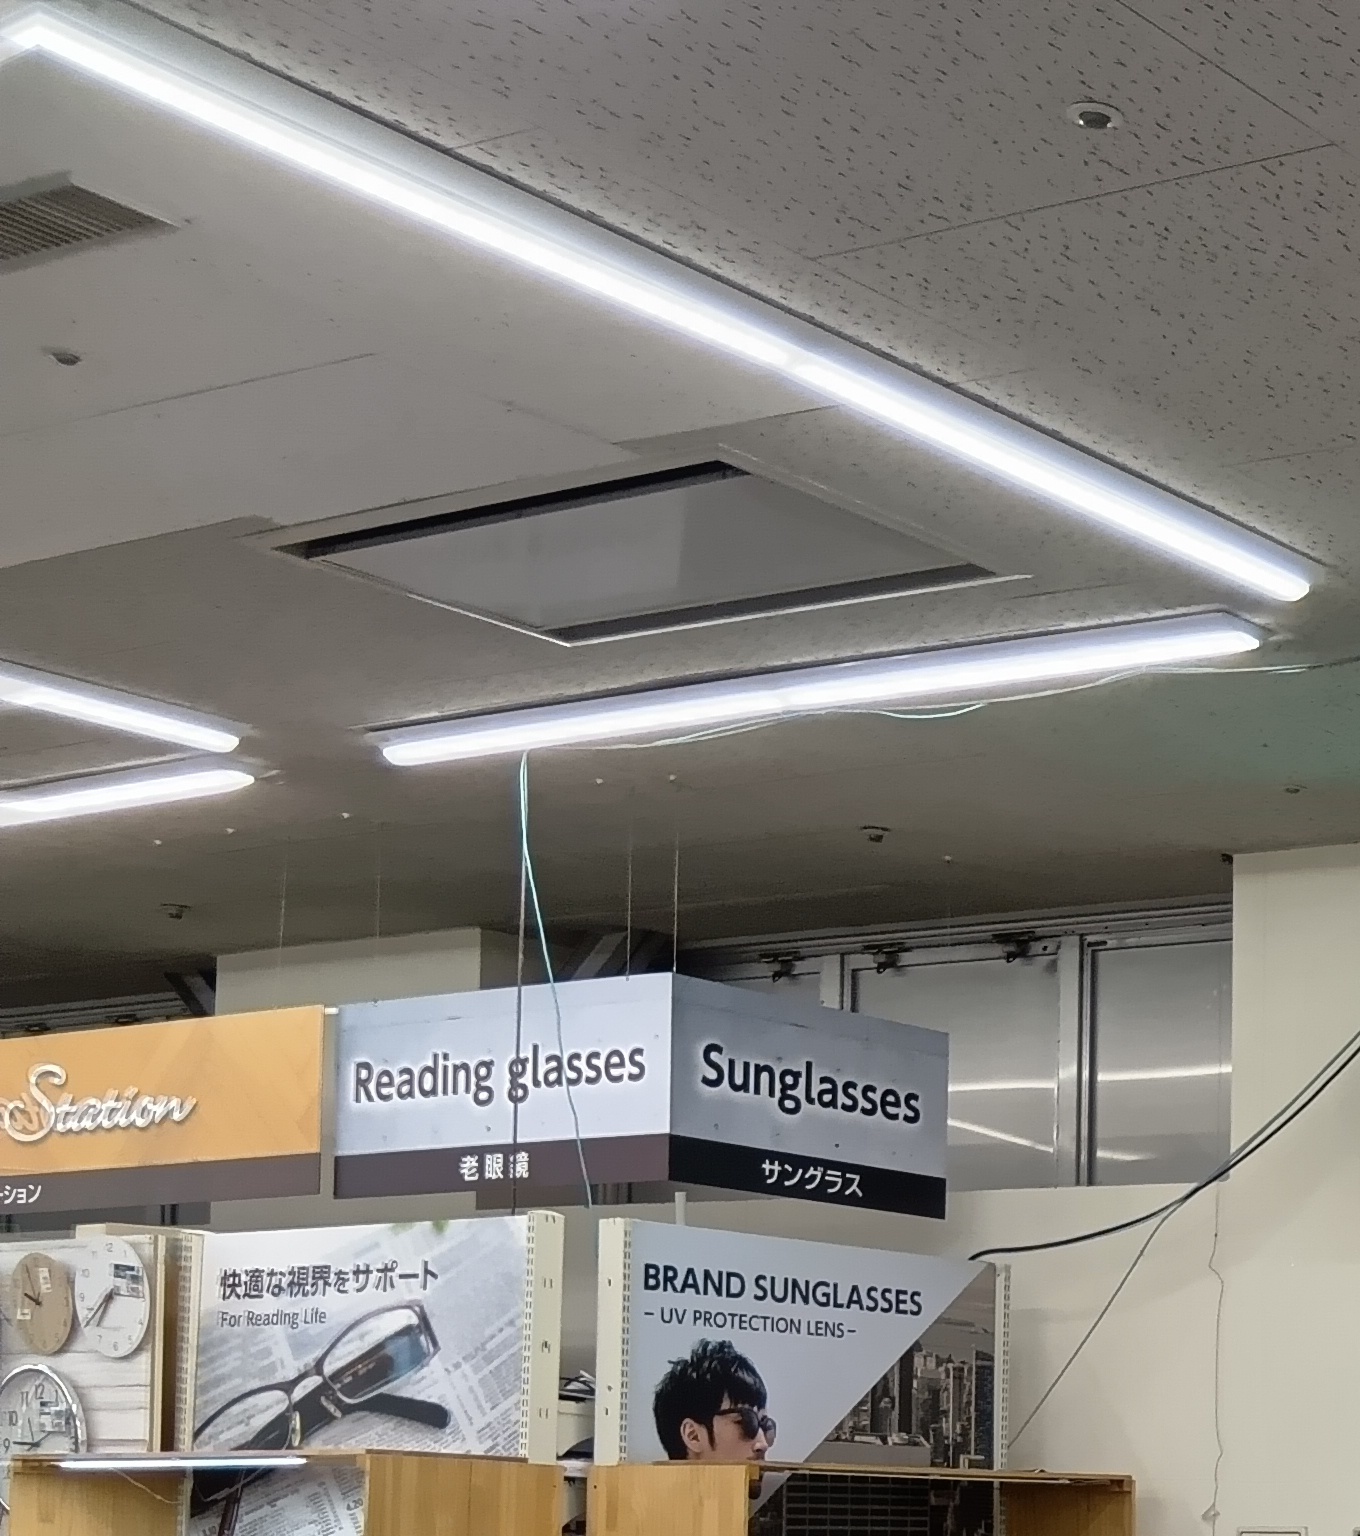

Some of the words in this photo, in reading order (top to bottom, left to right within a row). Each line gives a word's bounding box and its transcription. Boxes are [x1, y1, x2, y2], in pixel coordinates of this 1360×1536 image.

[354, 1052, 494, 1106] Reading
[507, 1043, 646, 1106] glasses
[700, 1043, 922, 1125] Sunglasses
[5, 1062, 198, 1142] Station
[459, 1151, 530, 1182] 老眼鏡
[761, 1159, 864, 1198] サングラス
[219, 1257, 440, 1301] 快適な視界をサポート
[643, 1262, 746, 1301] BRAND
[753, 1274, 923, 1317] SUNGLASSES
[220, 1309, 241, 1328] For
[246, 1307, 300, 1329] Reading
[303, 1307, 327, 1325] Life
[659, 1307, 687, 1327] UV
[692, 1309, 802, 1336] PROTECTION
[805, 1318, 846, 1339] LENS
